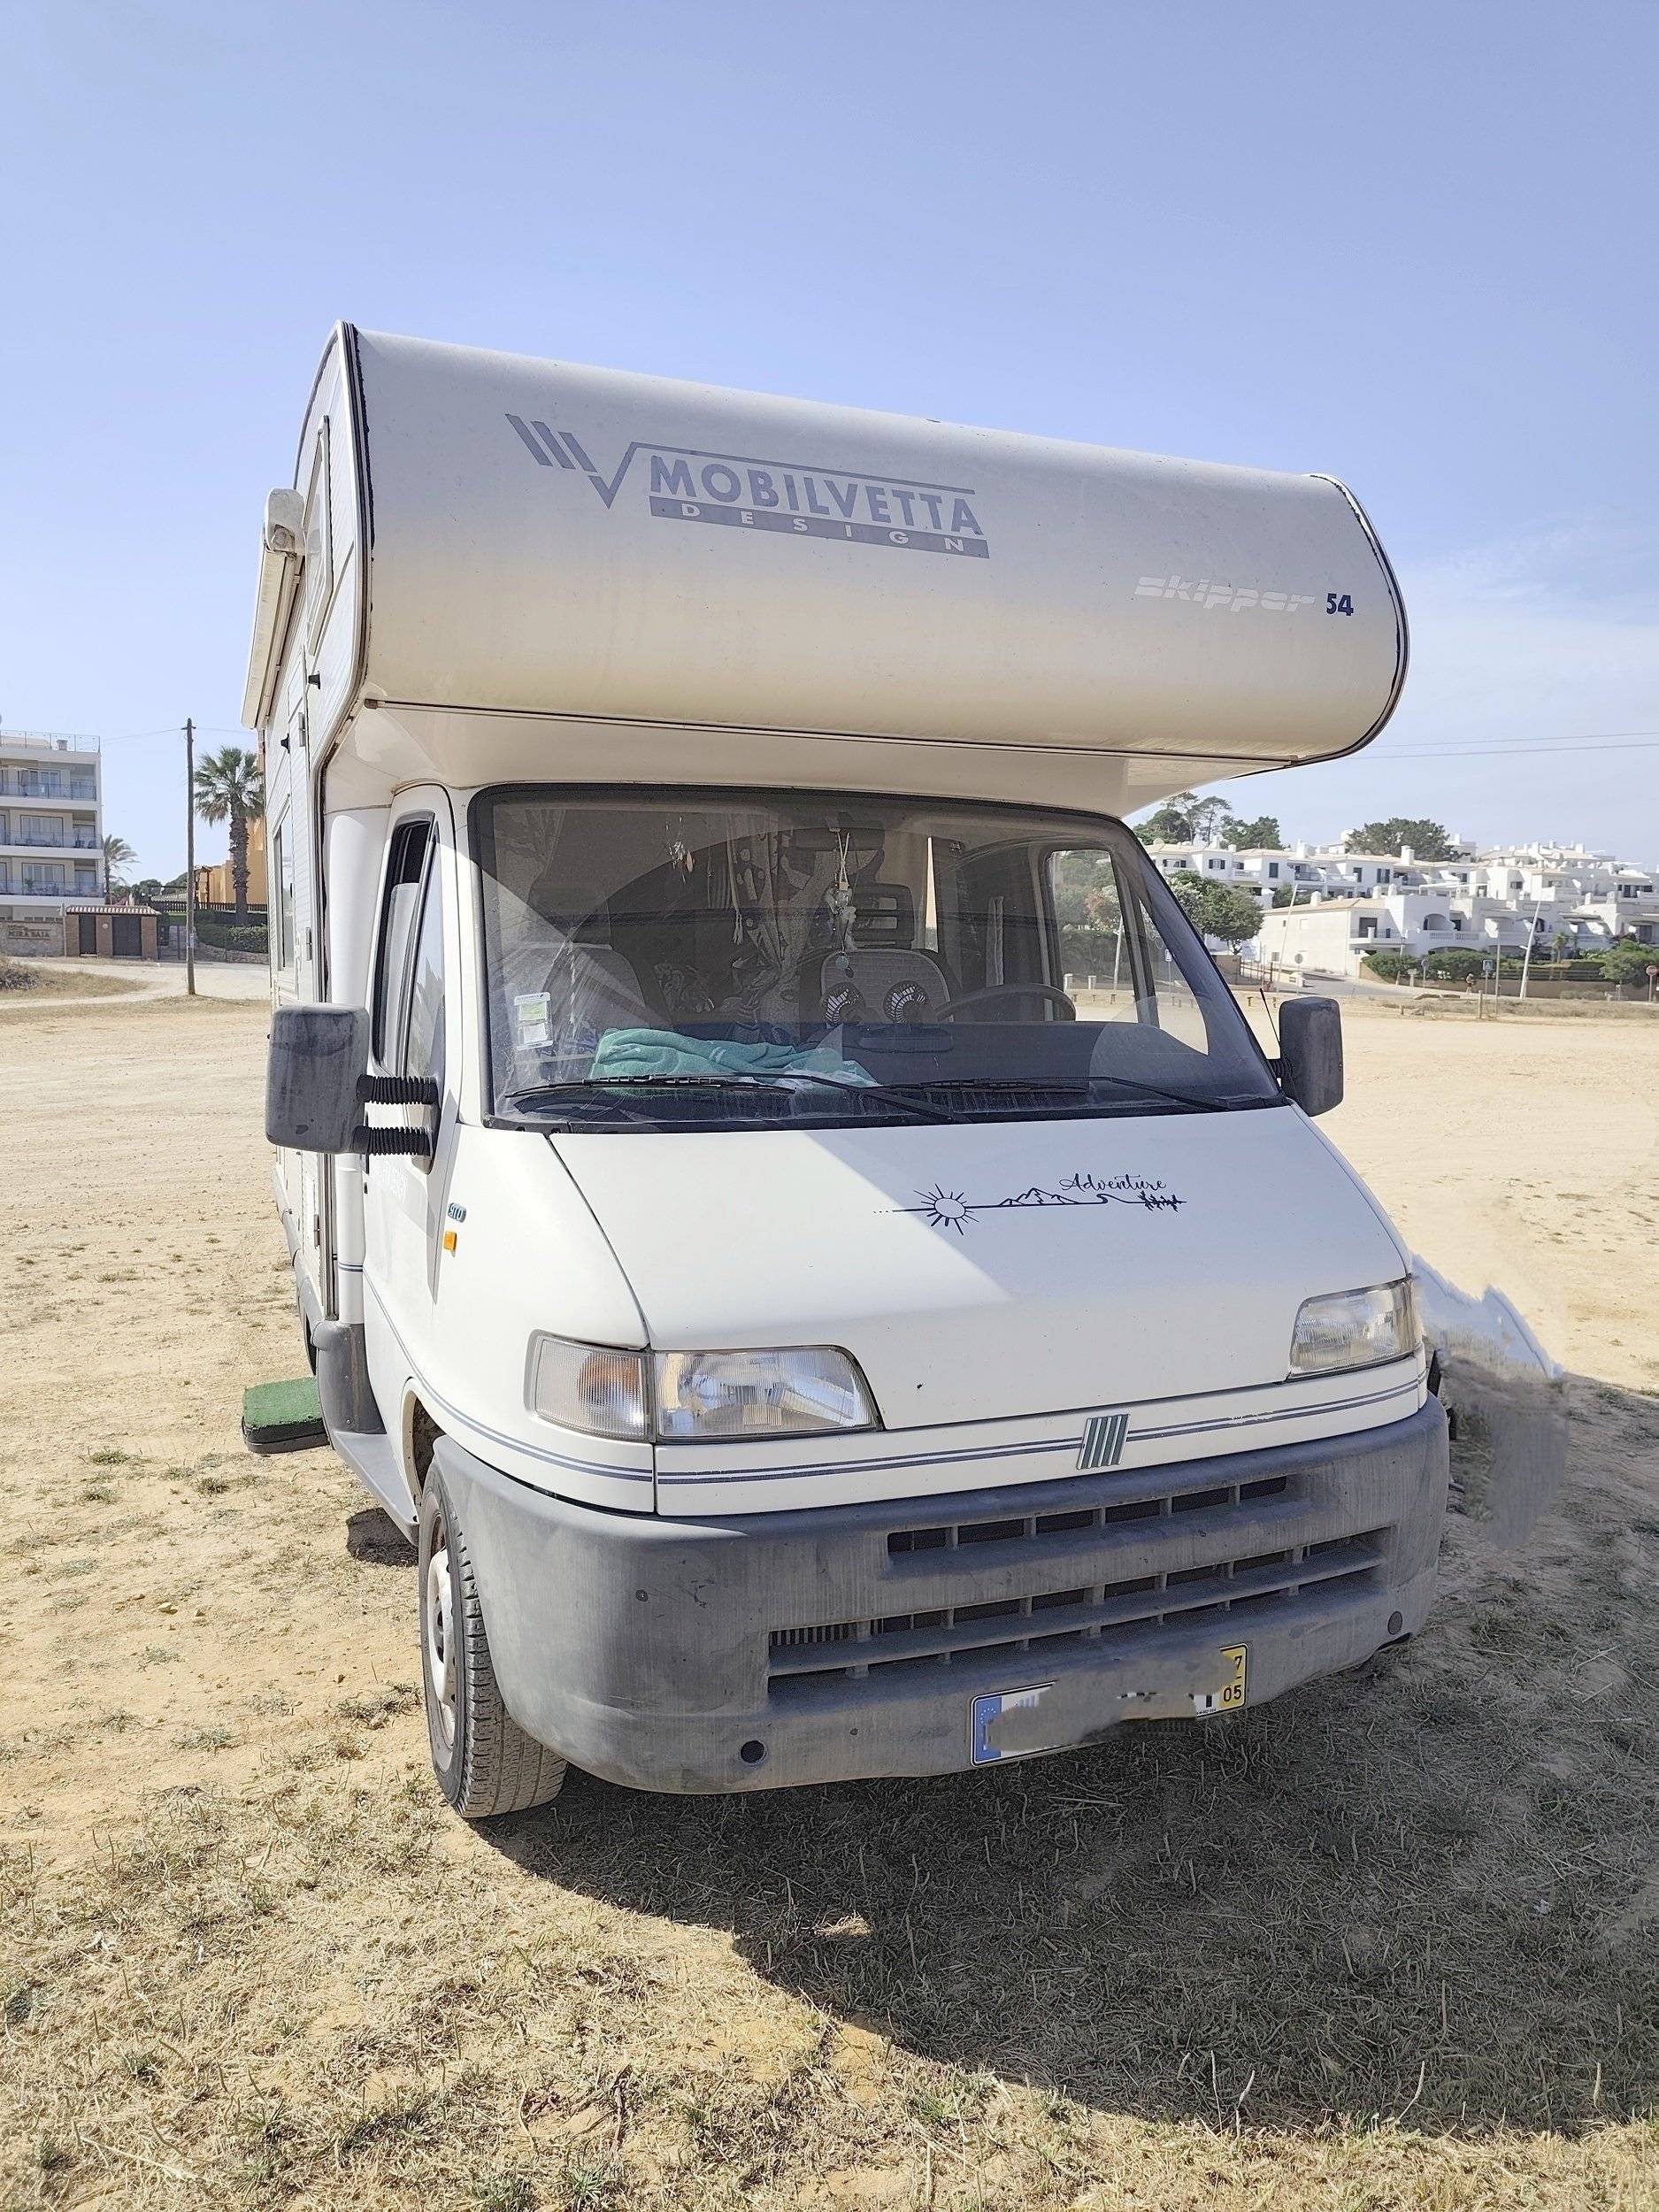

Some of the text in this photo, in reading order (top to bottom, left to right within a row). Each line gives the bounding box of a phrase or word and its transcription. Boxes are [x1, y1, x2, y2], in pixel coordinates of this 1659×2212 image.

[650, 455, 984, 535] MOBILVETTA
[680, 502, 965, 553] DESIGN
[1326, 593, 1355, 617] 54
[1059, 1173, 1167, 1192] Adventure
[1223, 1684, 1242, 1702] 05
